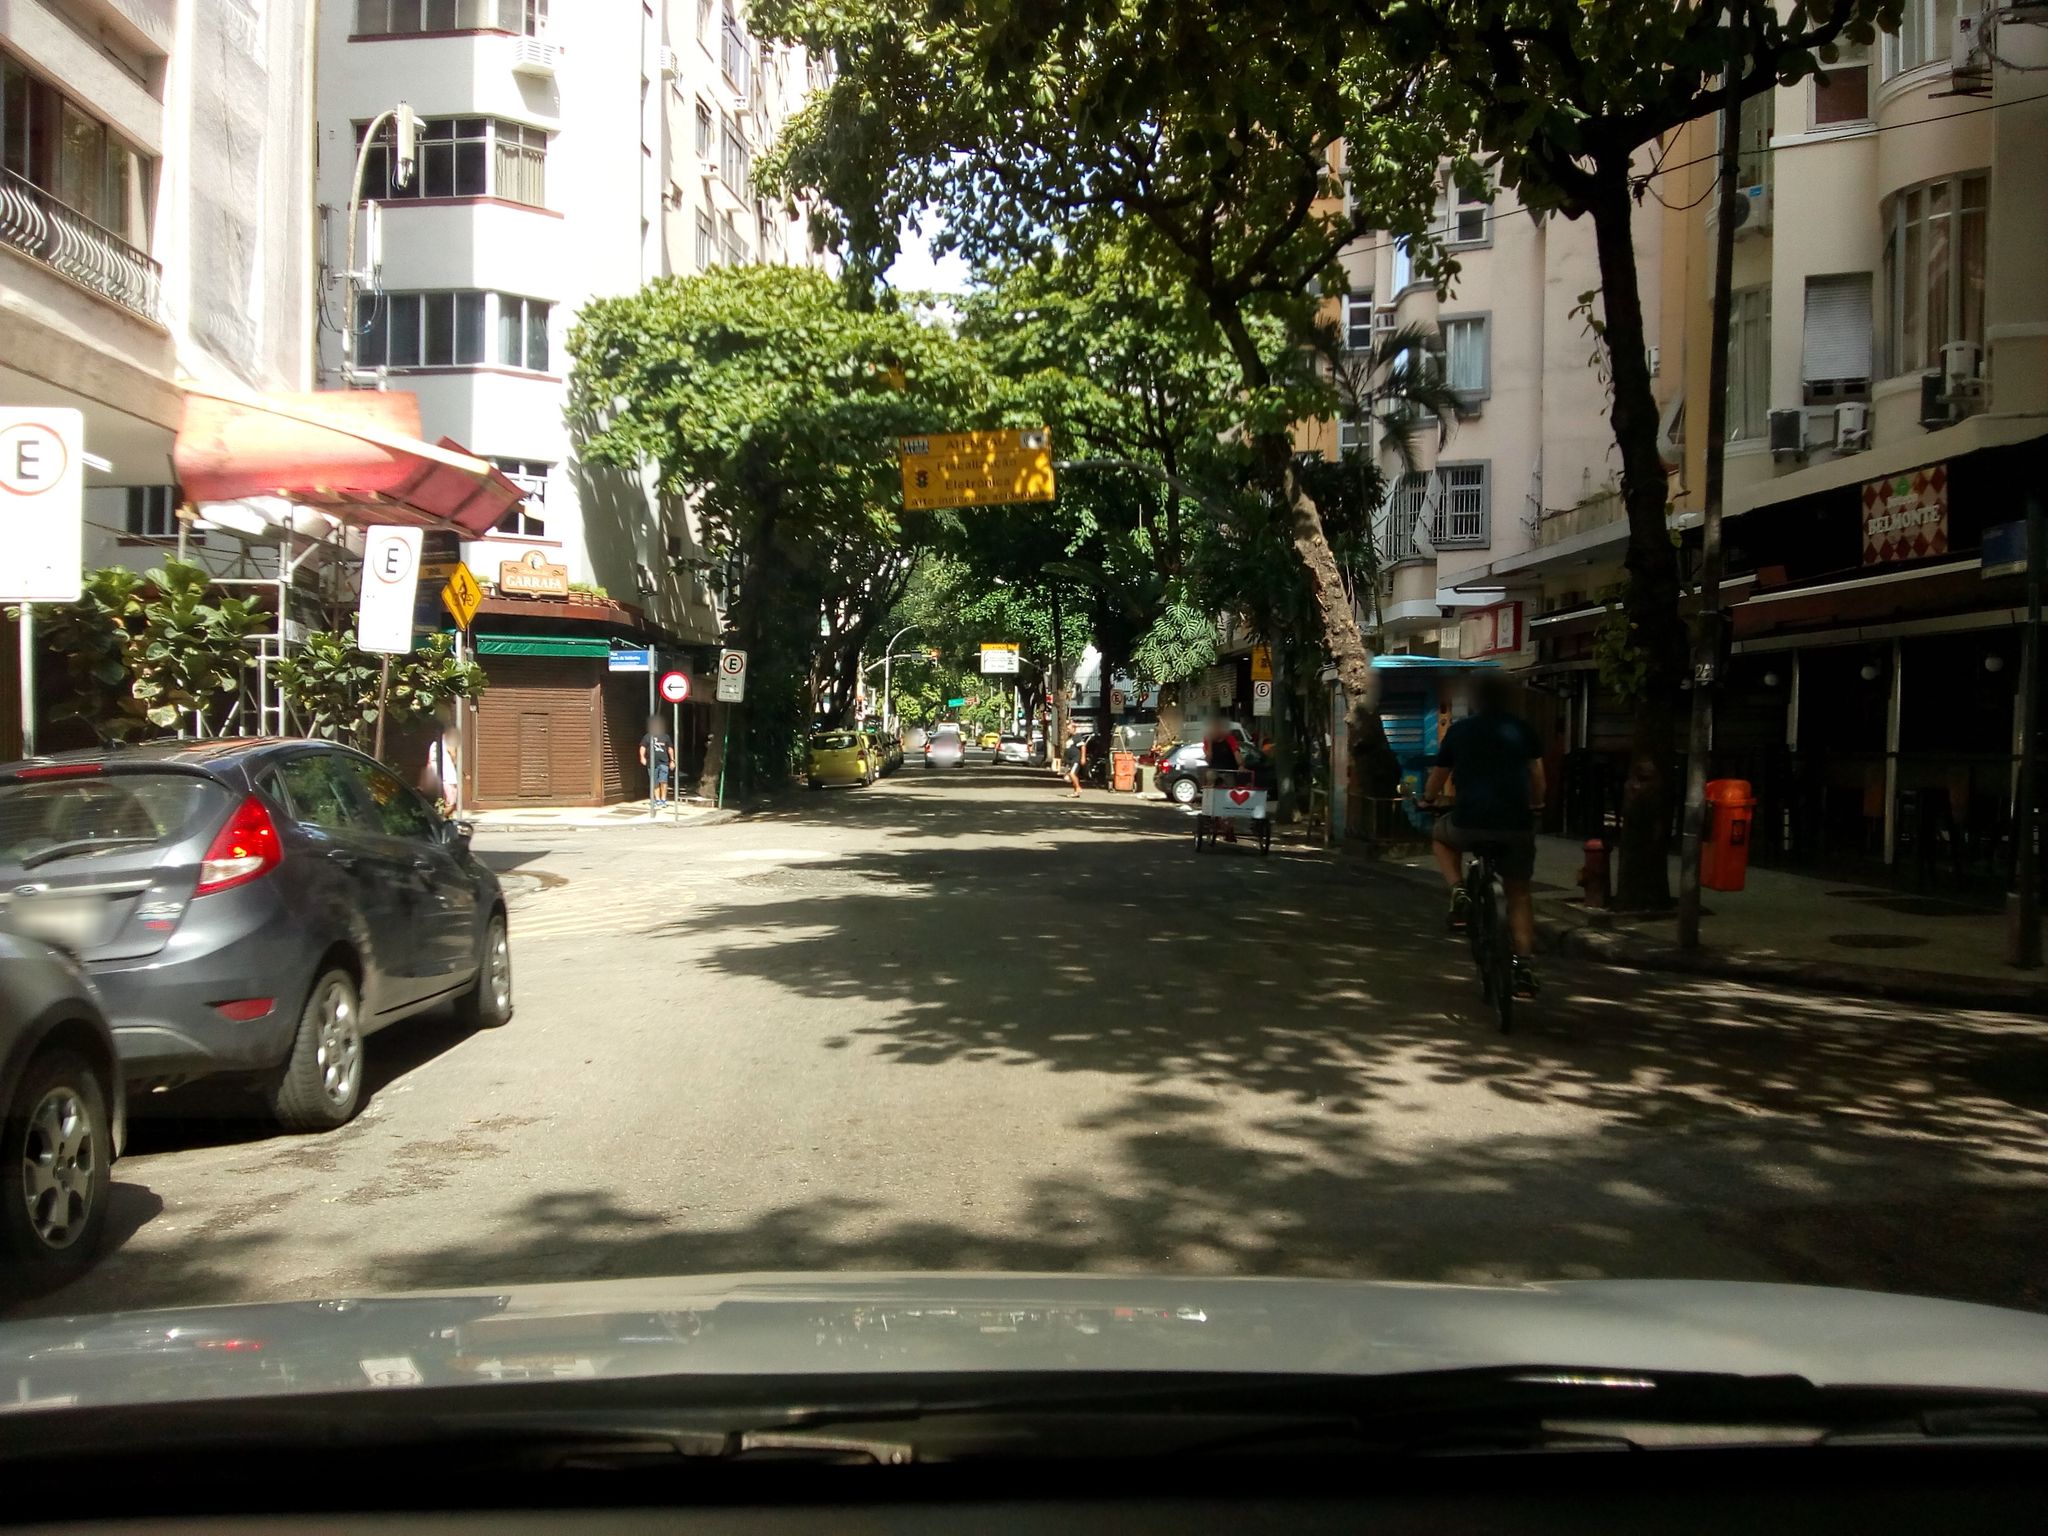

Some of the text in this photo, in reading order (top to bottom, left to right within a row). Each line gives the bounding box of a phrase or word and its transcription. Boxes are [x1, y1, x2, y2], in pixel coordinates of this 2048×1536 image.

[17, 440, 39, 480] E
[385, 548, 399, 574] E
[729, 658, 737, 670] E
[1260, 685, 1266, 694] E
